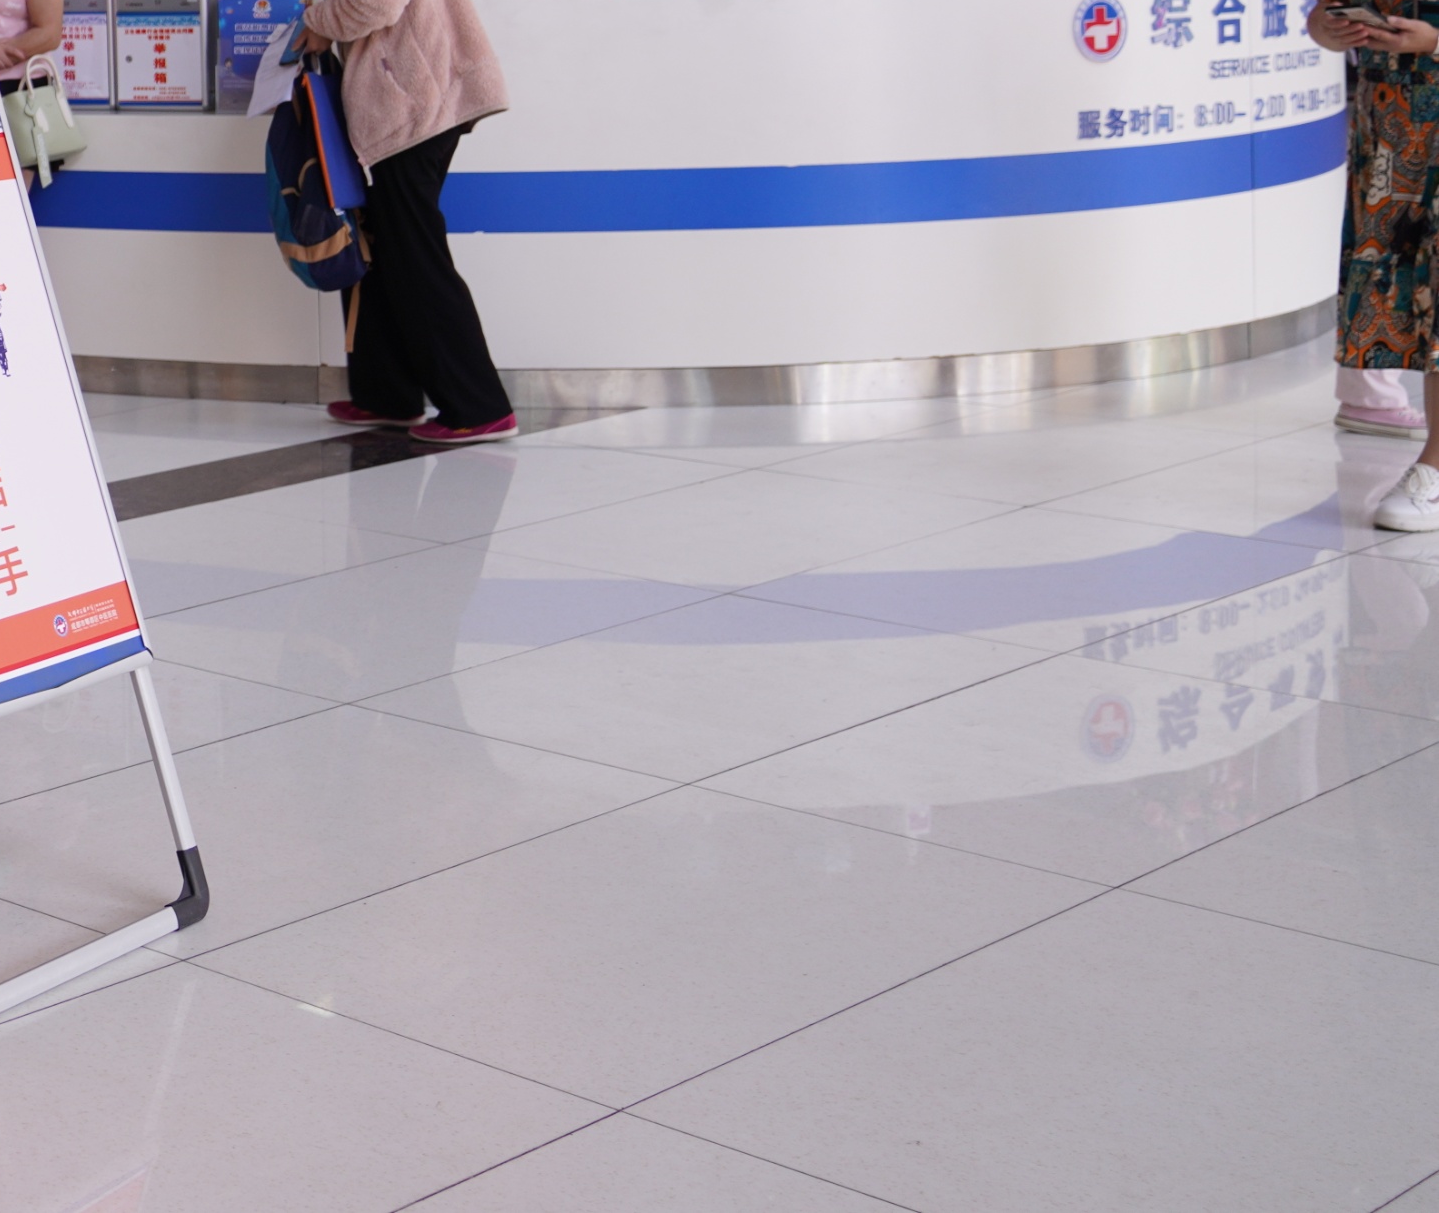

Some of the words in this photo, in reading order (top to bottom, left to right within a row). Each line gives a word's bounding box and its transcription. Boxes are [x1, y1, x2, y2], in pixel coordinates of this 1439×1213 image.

[63, 42, 76, 81] 举报箱
[153, 43, 167, 84] 举报箱
[1209, 56, 1271, 79] SERVICE
